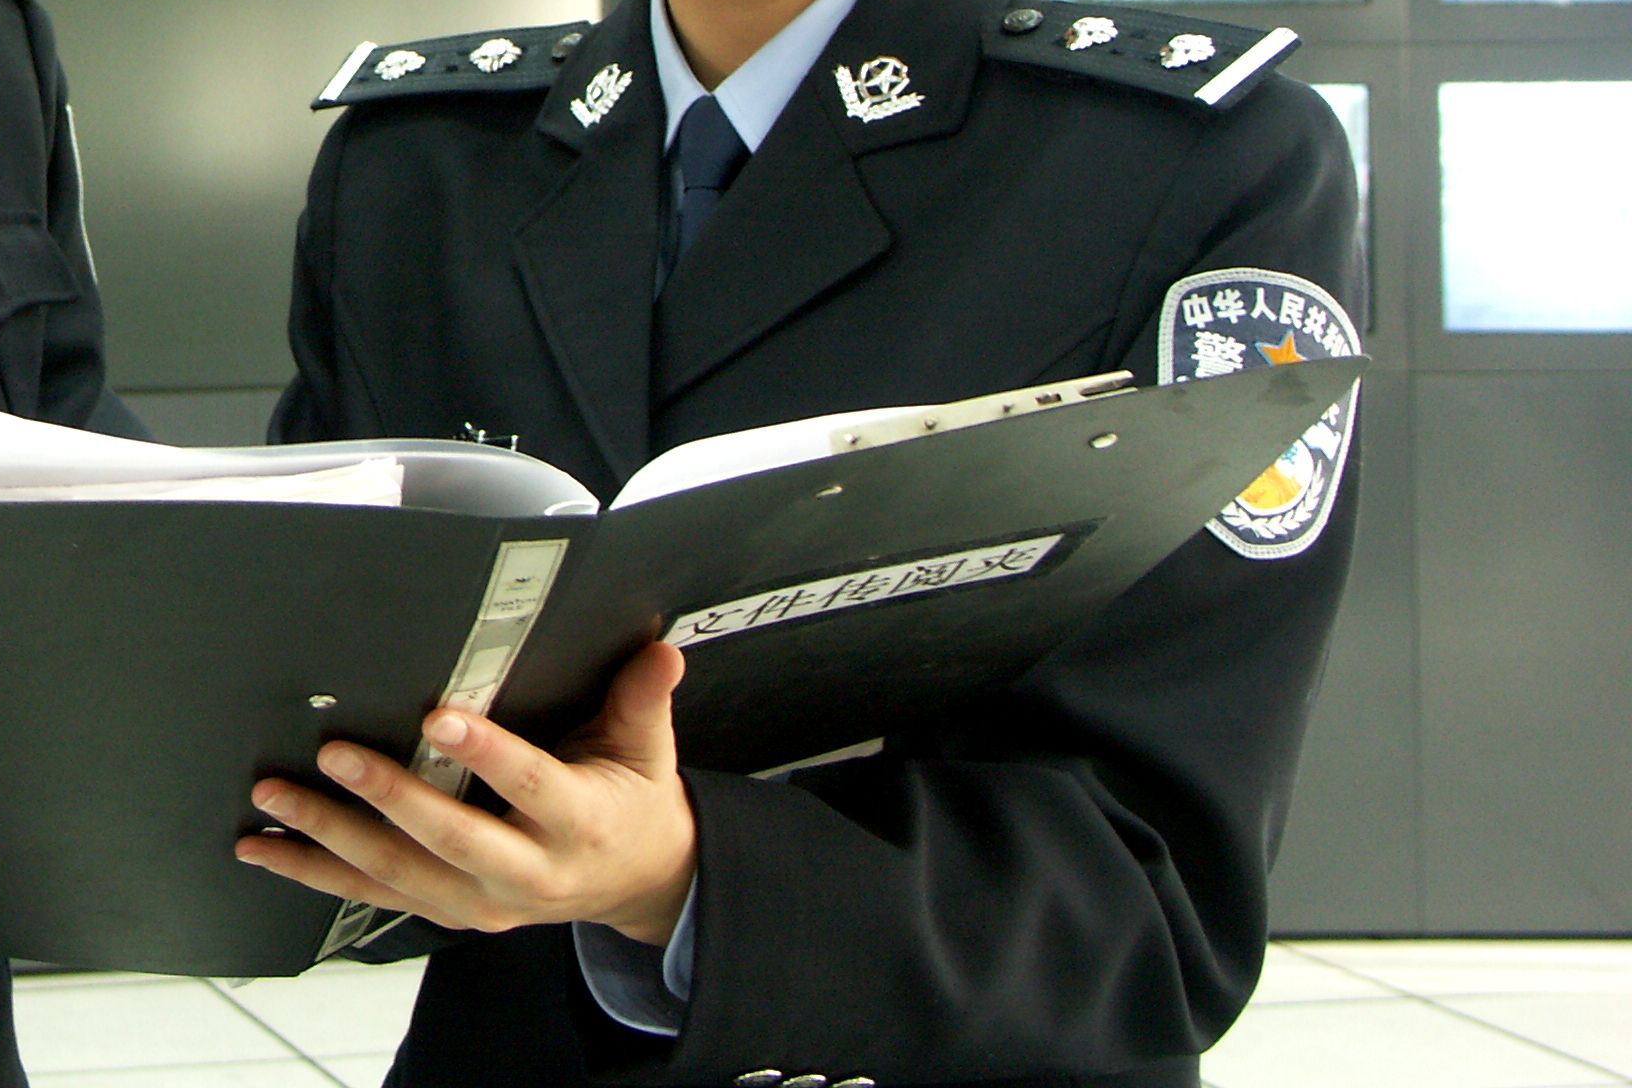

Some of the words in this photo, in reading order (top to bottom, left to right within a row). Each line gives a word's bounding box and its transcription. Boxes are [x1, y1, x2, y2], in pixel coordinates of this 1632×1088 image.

[674, 545, 1038, 646] 文件传阅夹
